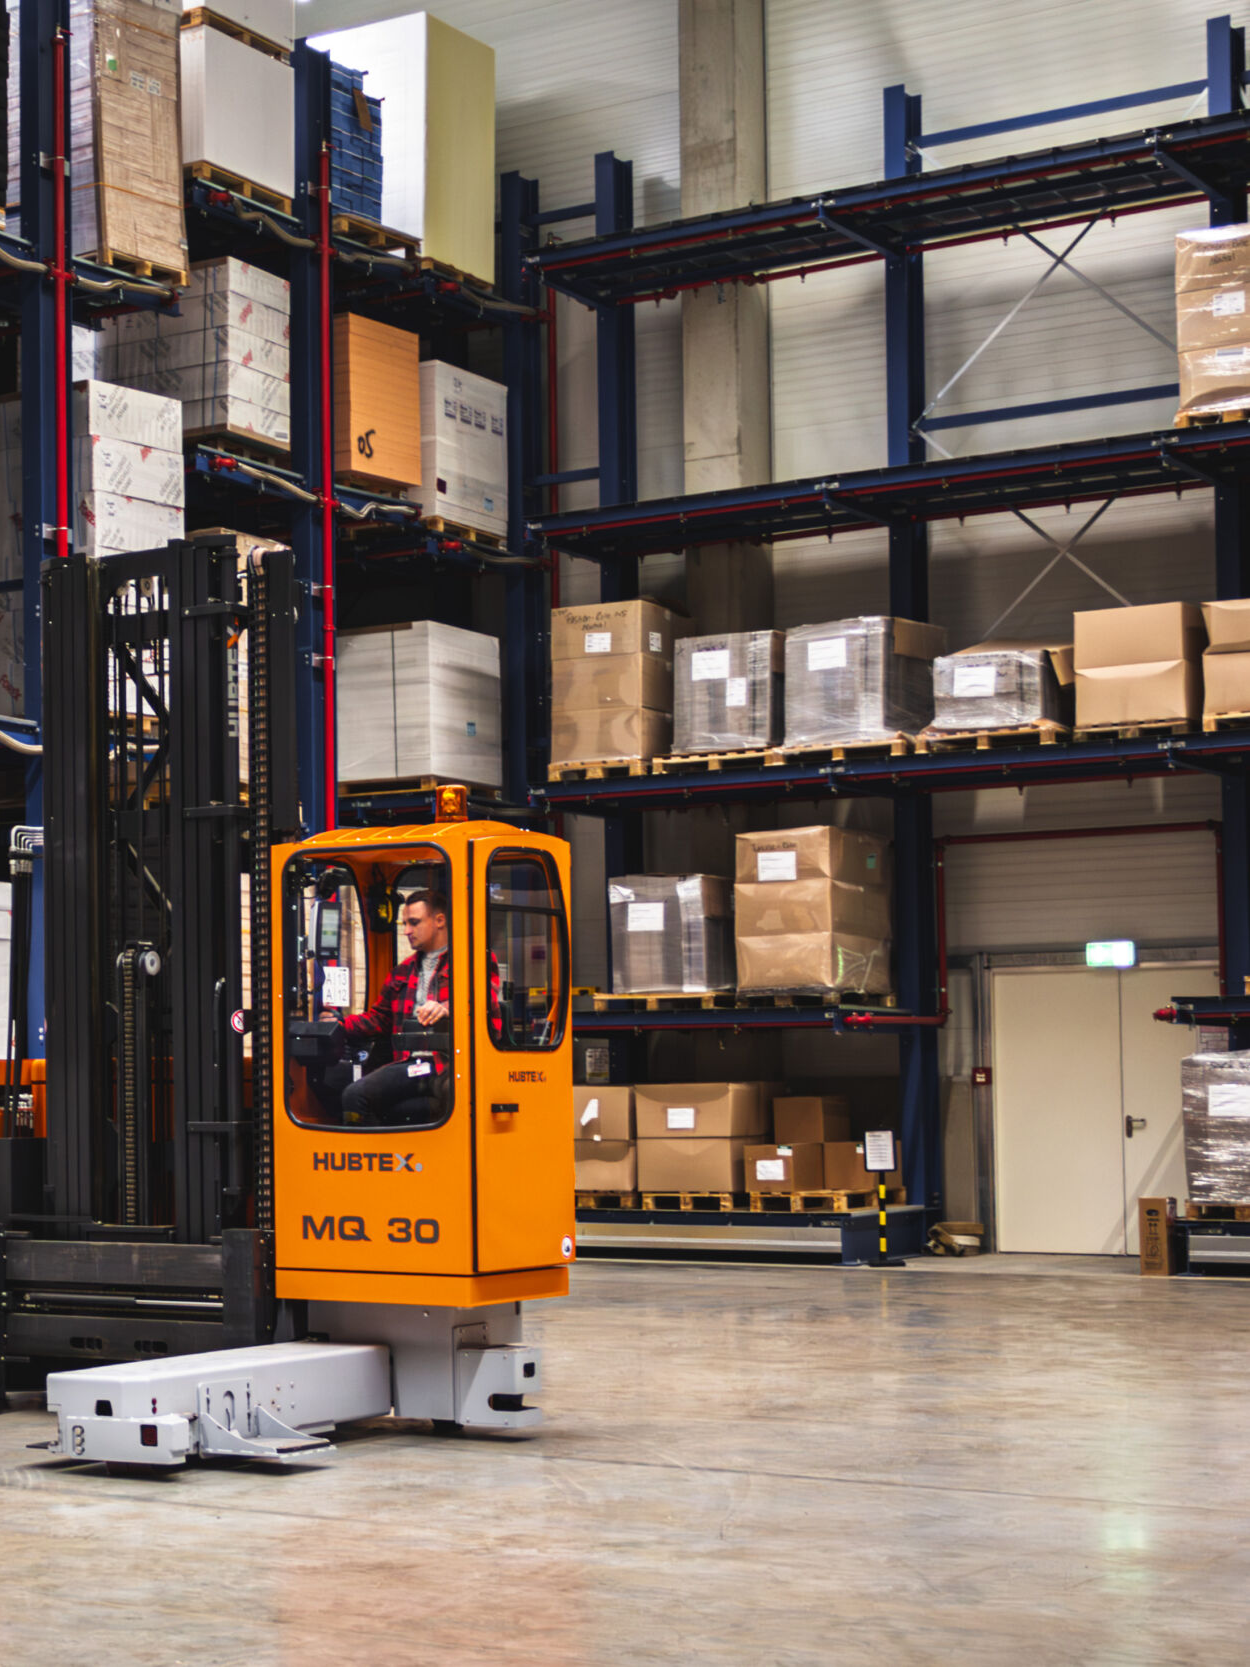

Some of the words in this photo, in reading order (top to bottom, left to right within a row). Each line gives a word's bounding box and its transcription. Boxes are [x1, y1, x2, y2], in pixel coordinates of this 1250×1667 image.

[357, 429, 376, 459] 05
[508, 1070, 544, 1083] HUBTEX
[312, 1151, 416, 1173] HUBTEX
[301, 1214, 373, 1242] MQ
[387, 1216, 441, 1245] 30
